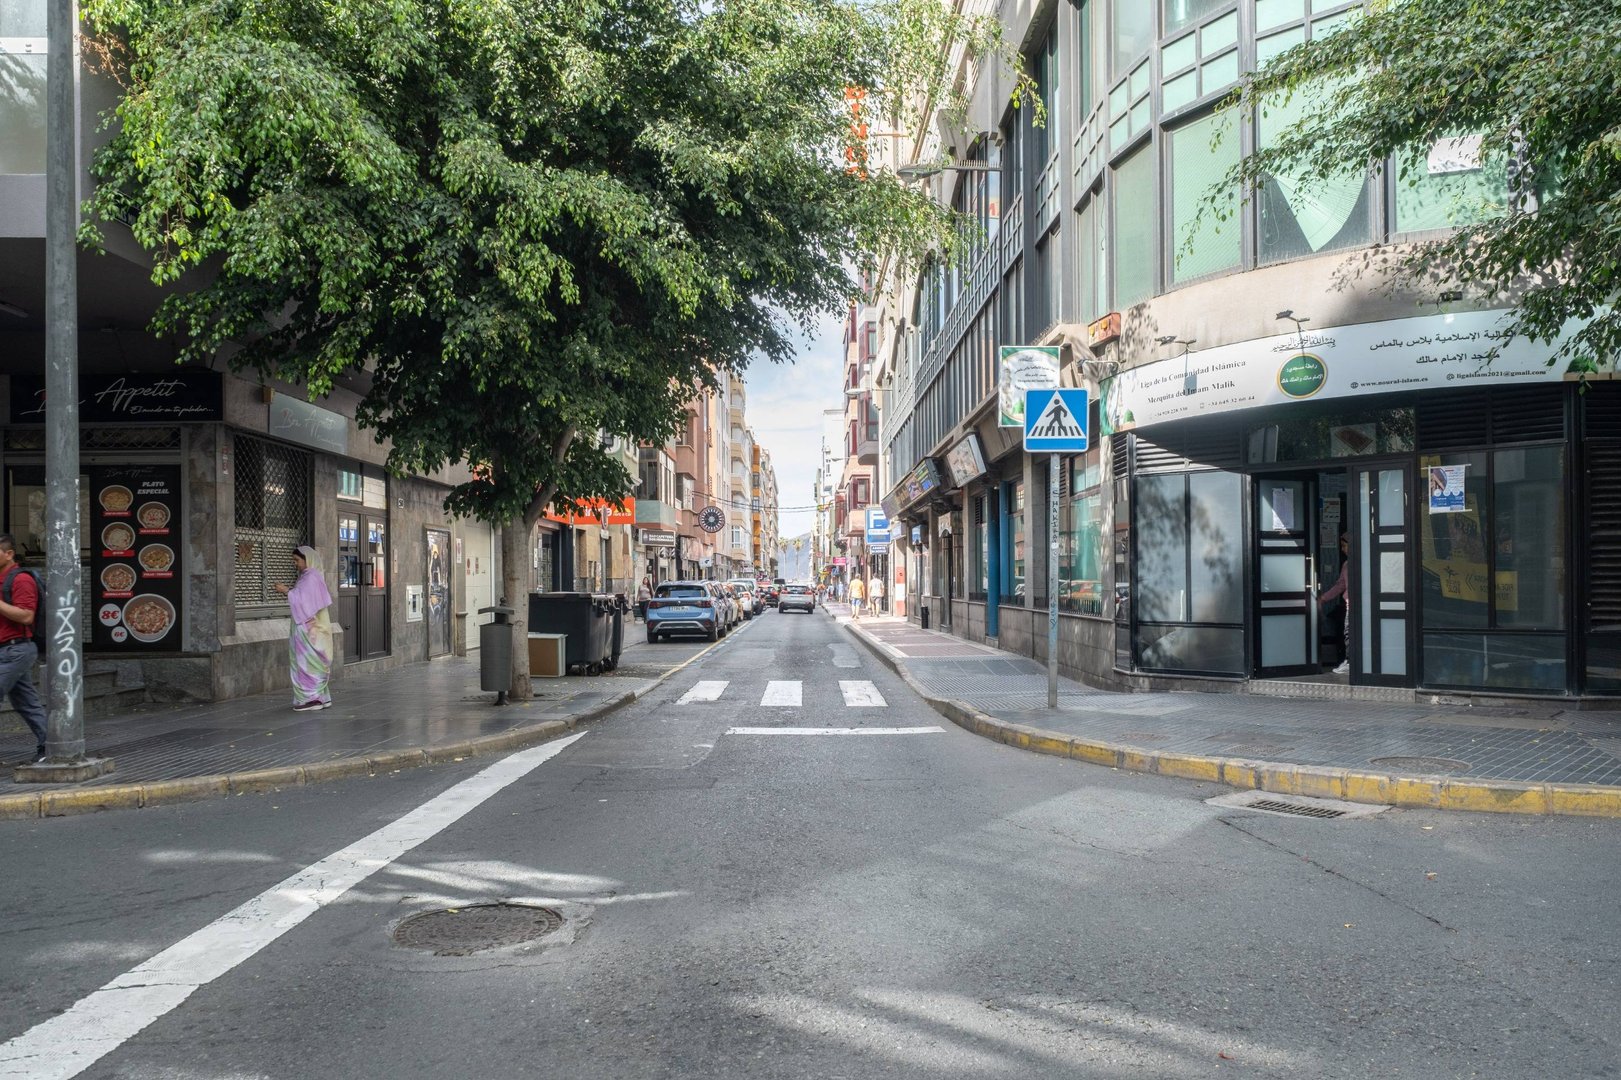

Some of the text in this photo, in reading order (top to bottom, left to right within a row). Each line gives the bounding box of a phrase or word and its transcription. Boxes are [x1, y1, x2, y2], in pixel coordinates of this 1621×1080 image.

[1406, 336, 1432, 347] بلاس
[1435, 331, 1480, 343] الإسلامية
[1369, 339, 1403, 351] بالماس
[1416, 352, 1500, 365] مجد الإمام مالك
[1211, 380, 1235, 390] Malik
[95, 378, 186, 411] Appetit
[101, 610, 119, 620] 8€
